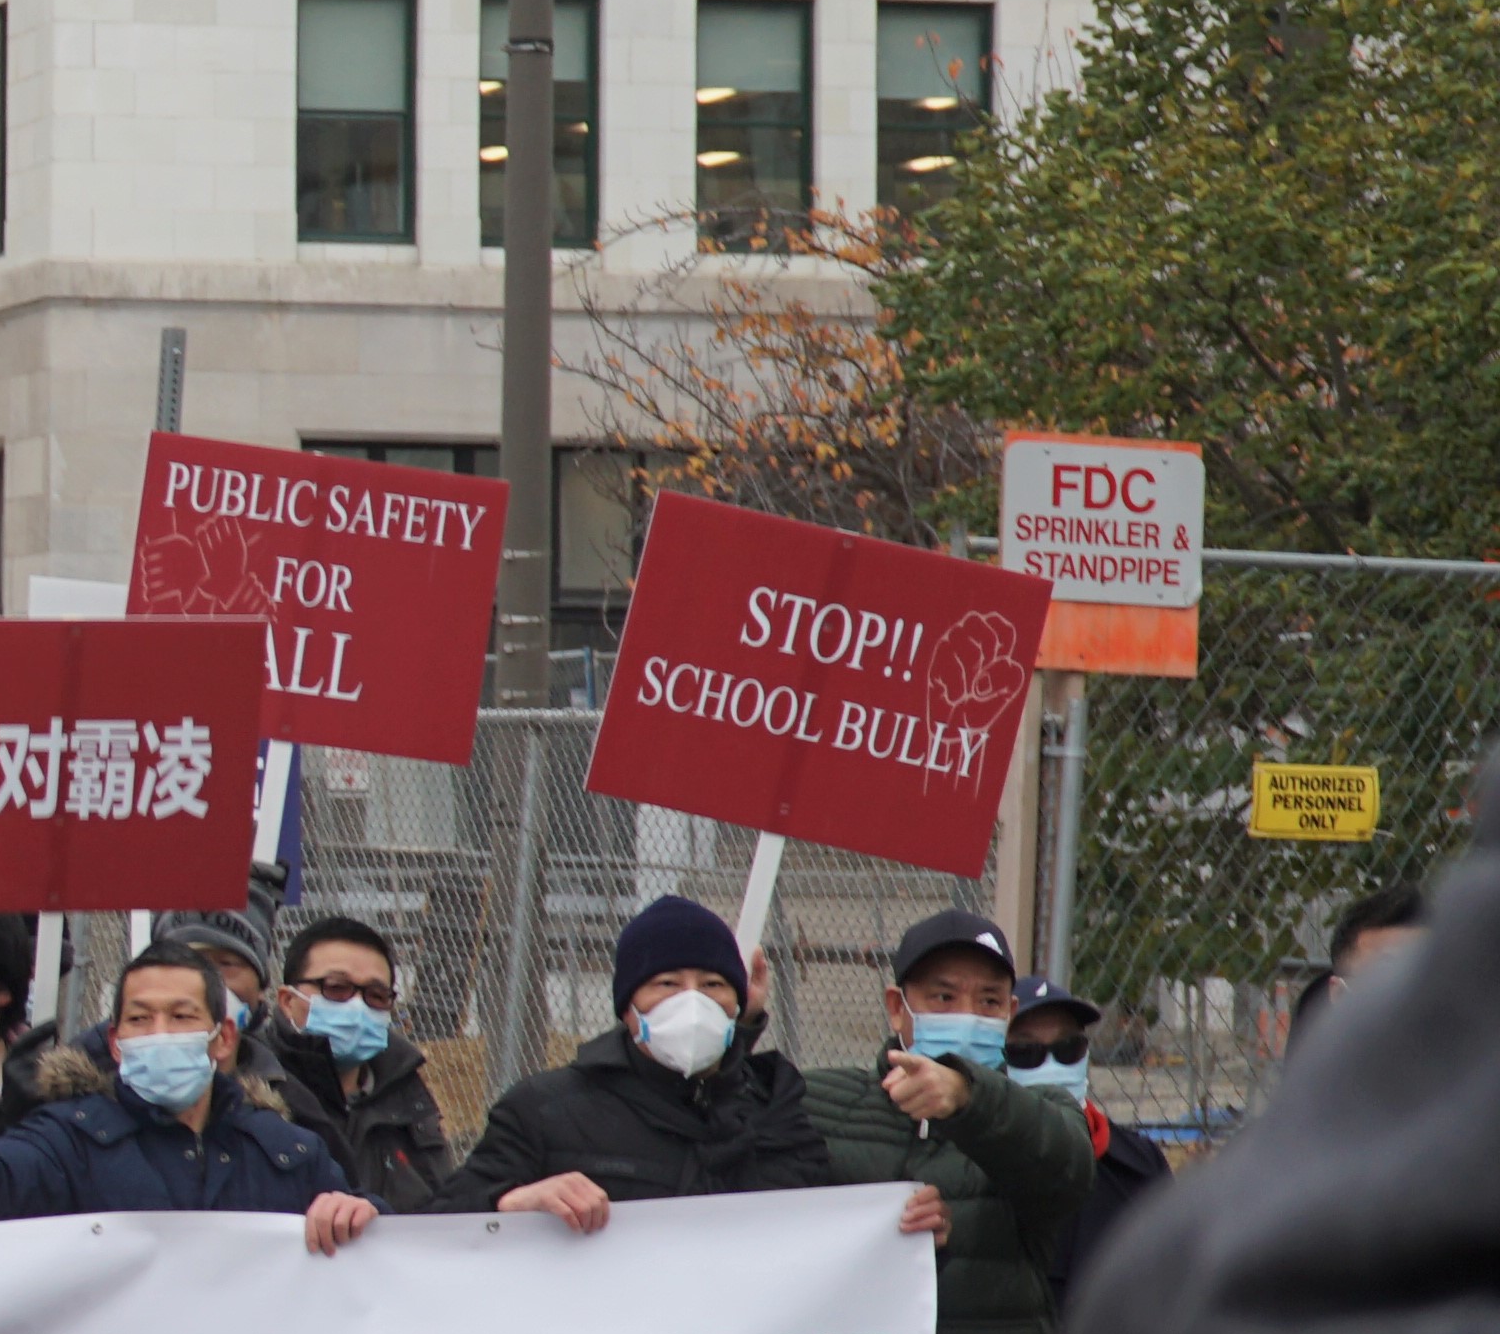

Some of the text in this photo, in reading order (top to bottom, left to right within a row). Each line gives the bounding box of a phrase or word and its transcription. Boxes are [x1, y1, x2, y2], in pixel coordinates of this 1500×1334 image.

[164, 460, 487, 551] PUBLIC SAFETY
[1051, 464, 1157, 514] FDC
[1014, 514, 1190, 551] SPRINKLER &
[273, 557, 354, 613] FOR
[1023, 550, 1181, 587] STANDPIPE
[740, 586, 925, 684] STOP!!
[637, 656, 990, 780] SCHOOL BULLY
[1269, 775, 1366, 793] AUTHORIZED
[1272, 793, 1365, 812] PERSONNEL
[1298, 814, 1339, 830] ONLY
